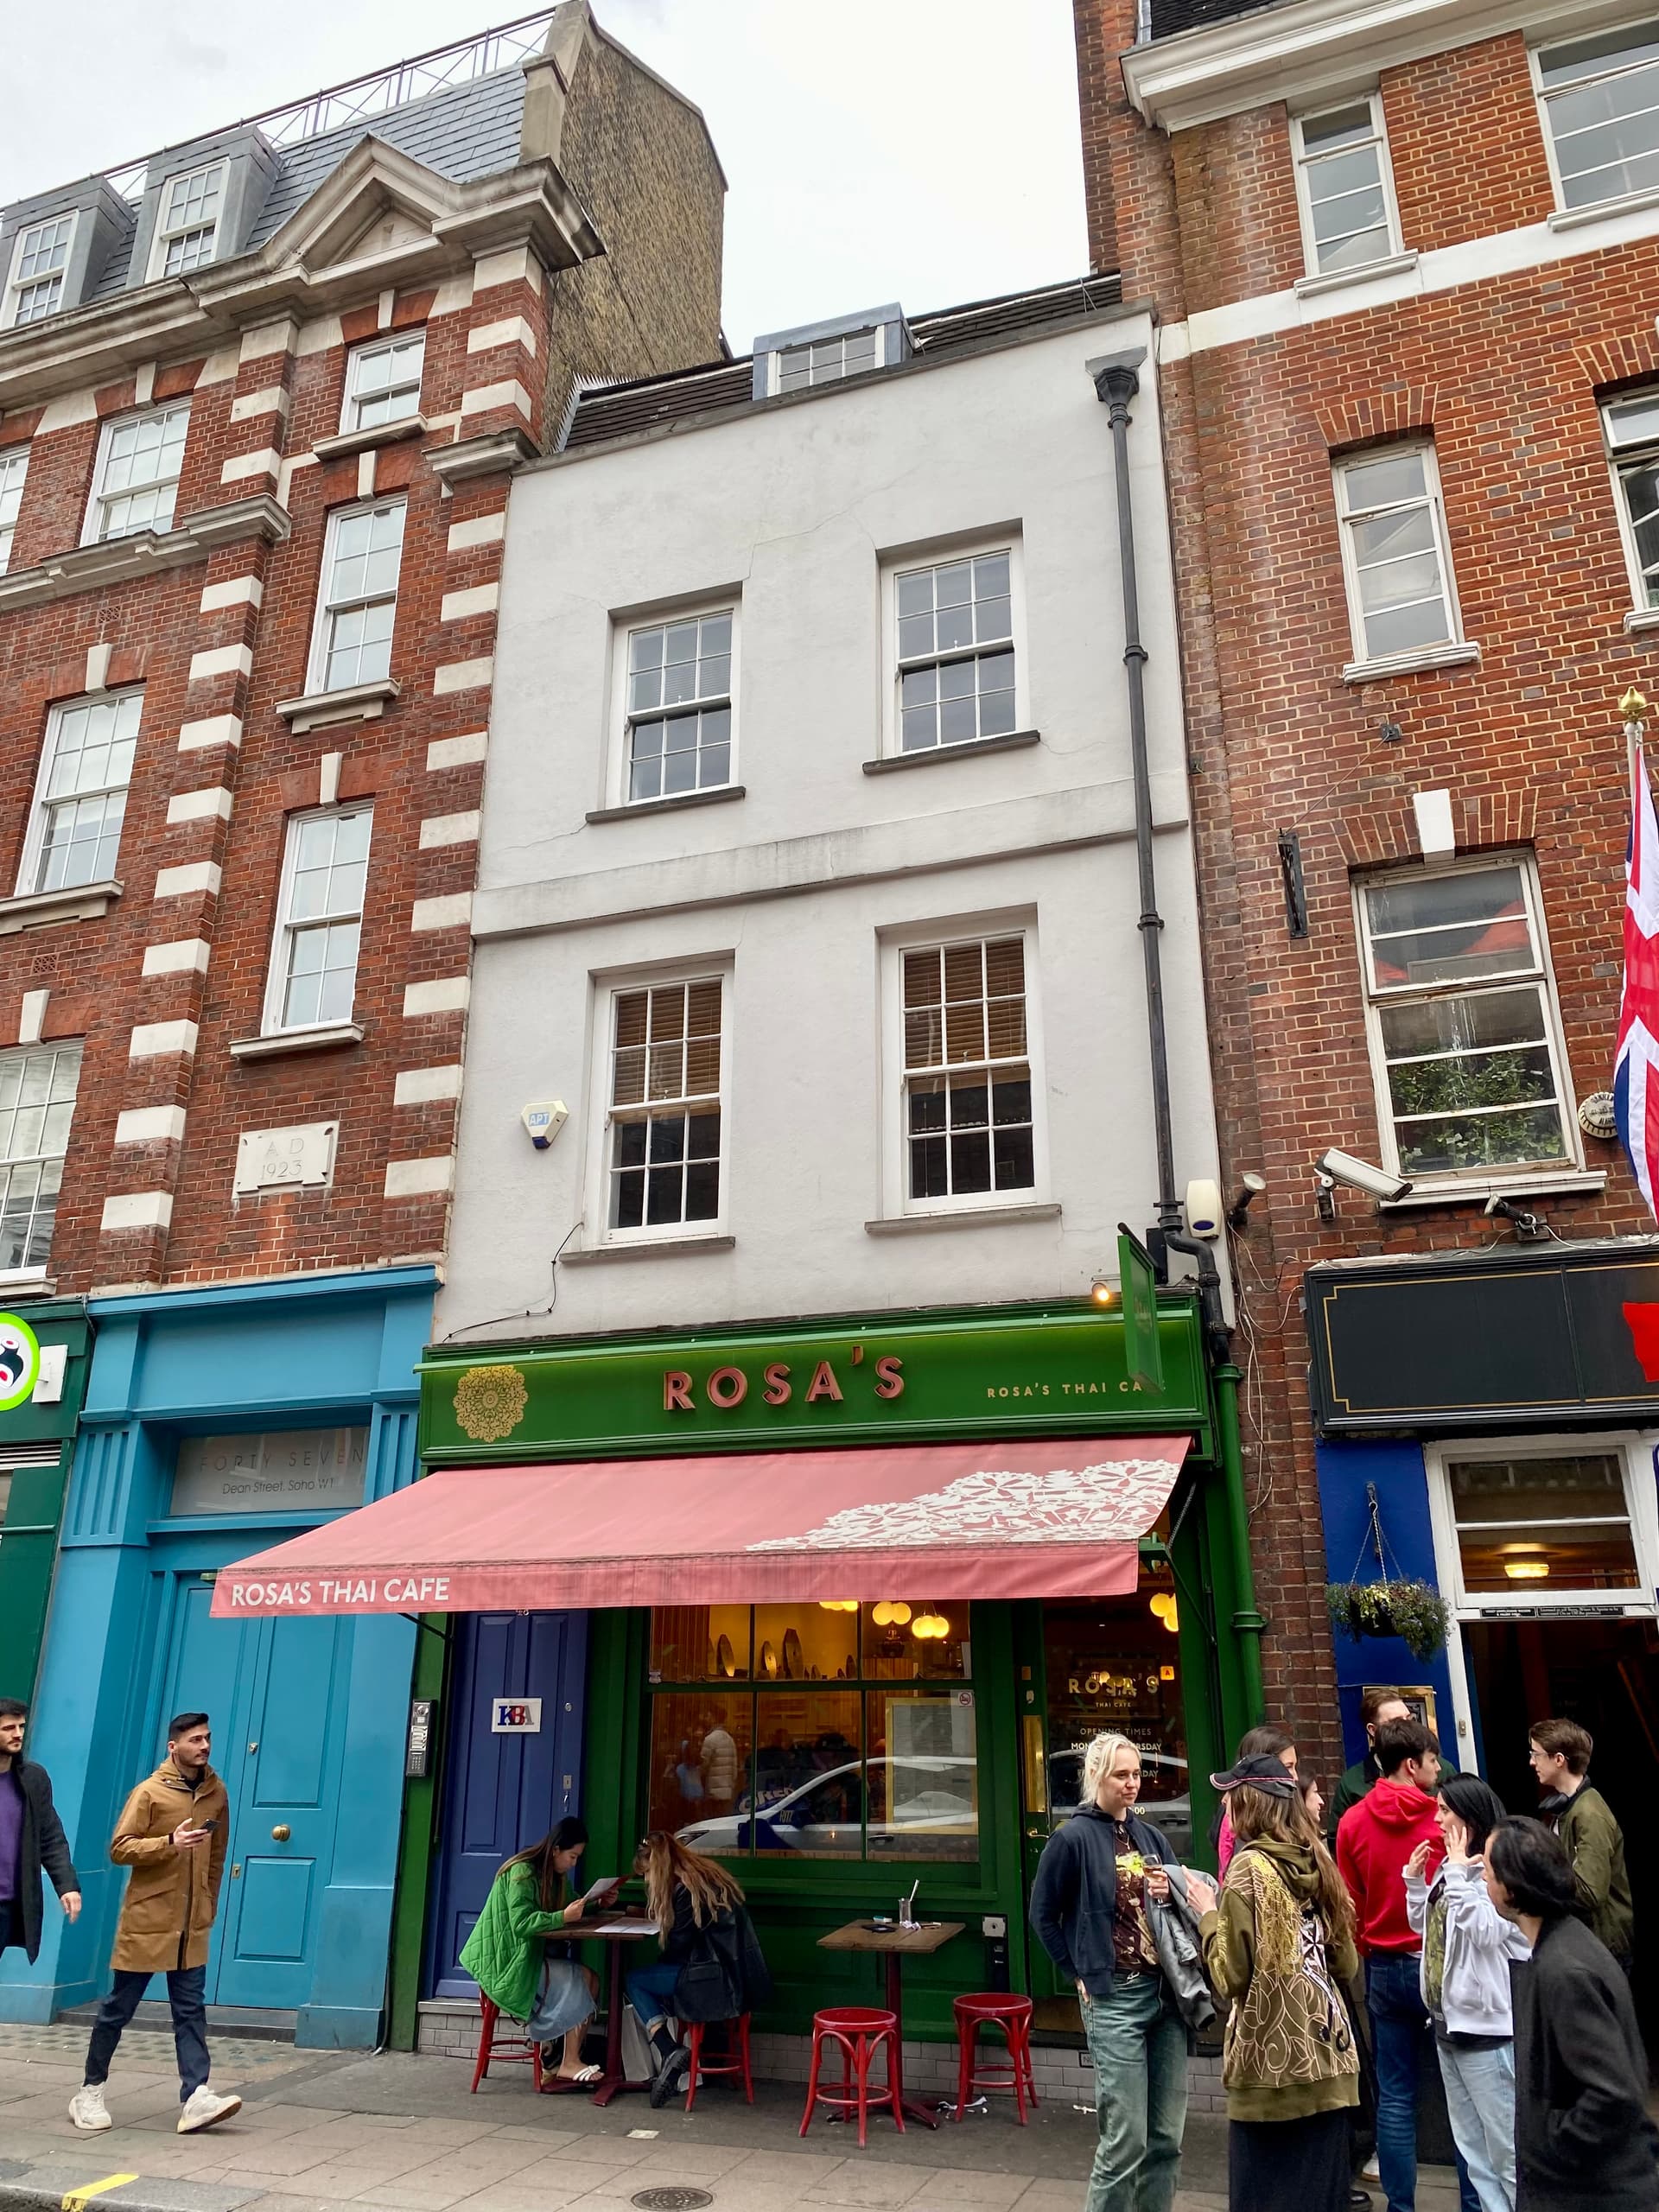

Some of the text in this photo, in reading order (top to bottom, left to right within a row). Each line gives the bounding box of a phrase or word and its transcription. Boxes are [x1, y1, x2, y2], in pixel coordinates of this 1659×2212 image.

[529, 1113, 549, 1125] APT
[266, 1138, 304, 1156] A D
[261, 1160, 302, 1180] 1923
[664, 1344, 905, 1410] ROSA'S
[987, 1381, 1143, 1398] ROSA'S THAI CA
[200, 1447, 364, 1471] FORTY SEVEN
[223, 1482, 251, 1495] Dean
[288, 1478, 315, 1491] Soho
[319, 1478, 334, 1490] W1
[232, 1577, 450, 1606] ROSA'S THAI CAFE
[1068, 1675, 1159, 1694] ROSA'S
[1125, 1727, 1152, 1736] TIMES
